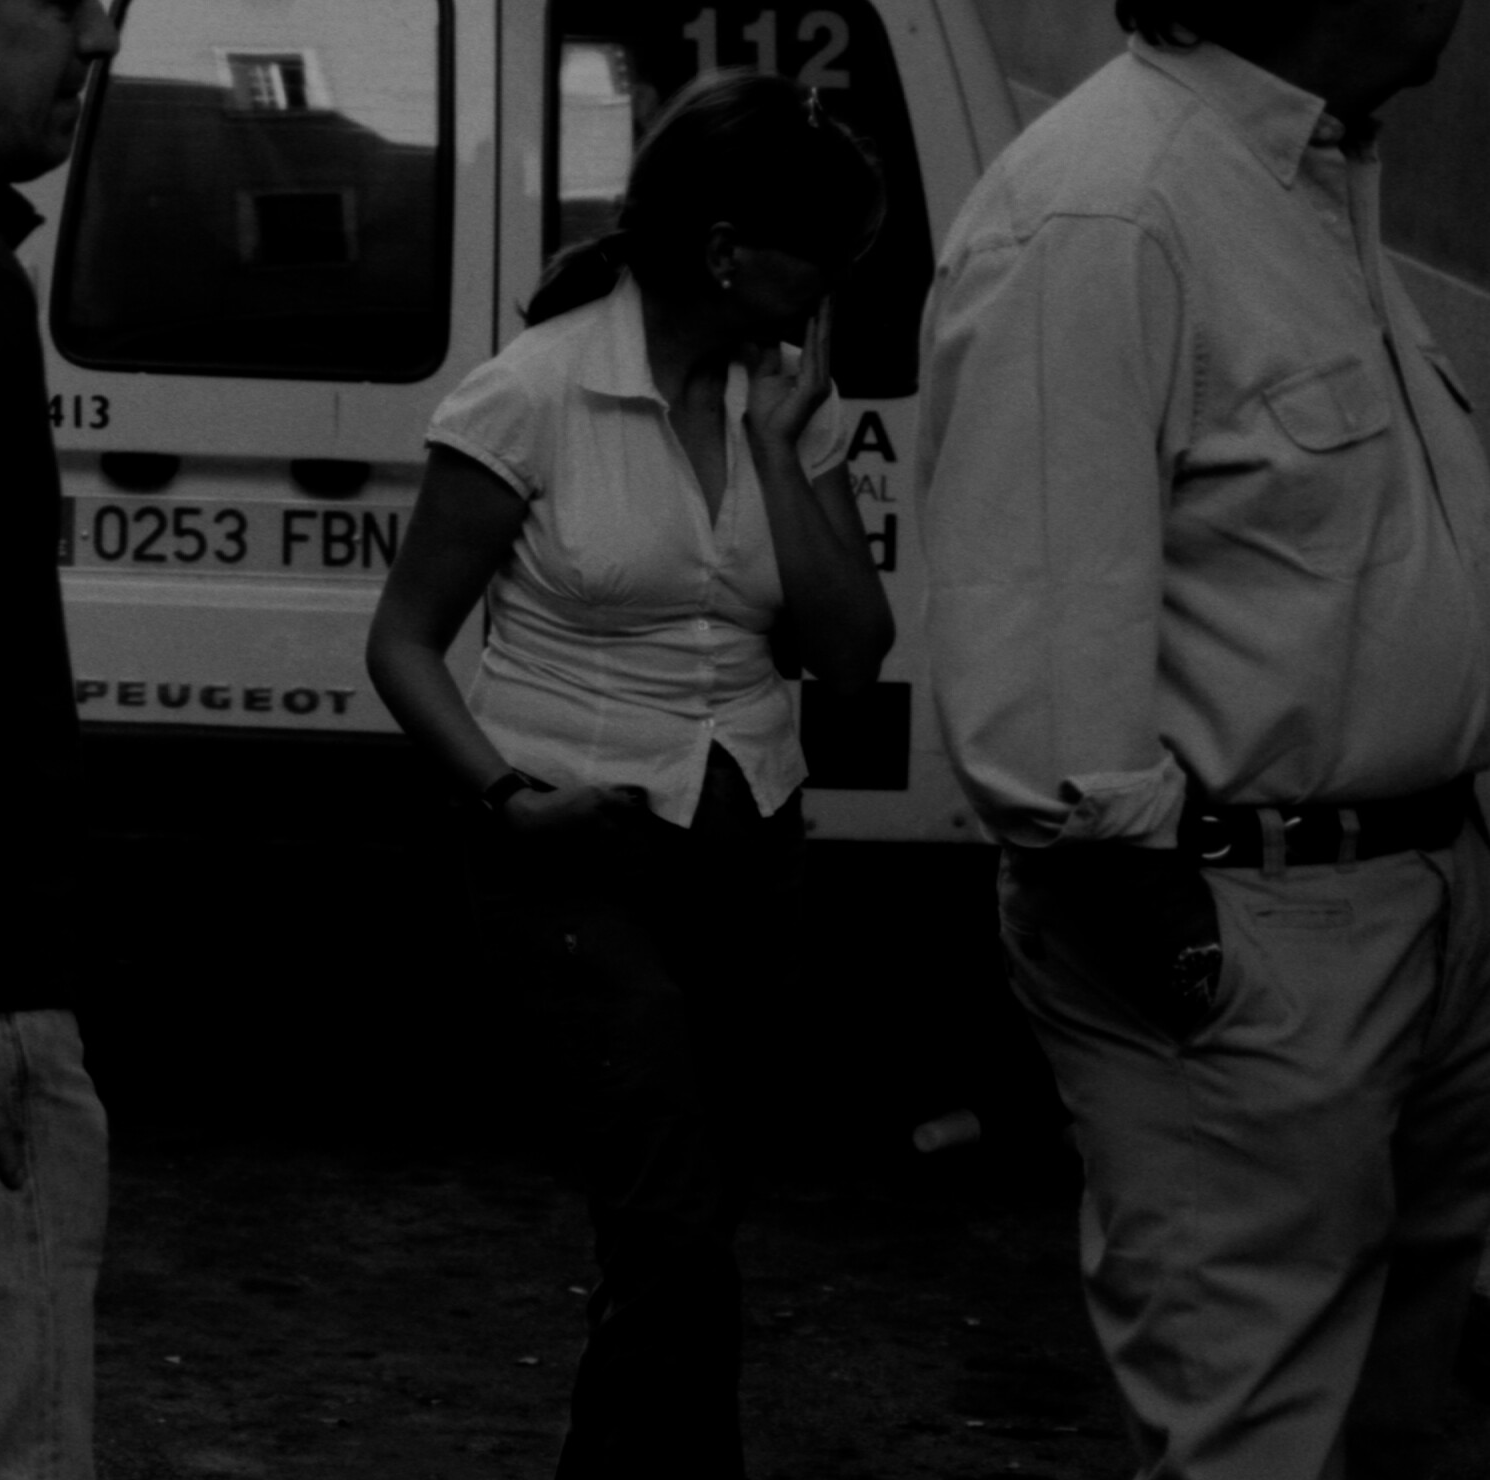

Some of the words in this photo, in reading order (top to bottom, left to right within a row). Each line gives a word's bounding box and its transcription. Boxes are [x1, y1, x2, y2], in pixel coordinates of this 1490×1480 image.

[682, 6, 851, 89] 112
[92, 505, 249, 565] 0253
[280, 507, 399, 569] FBN
[74, 679, 358, 715] PEUGEOT
